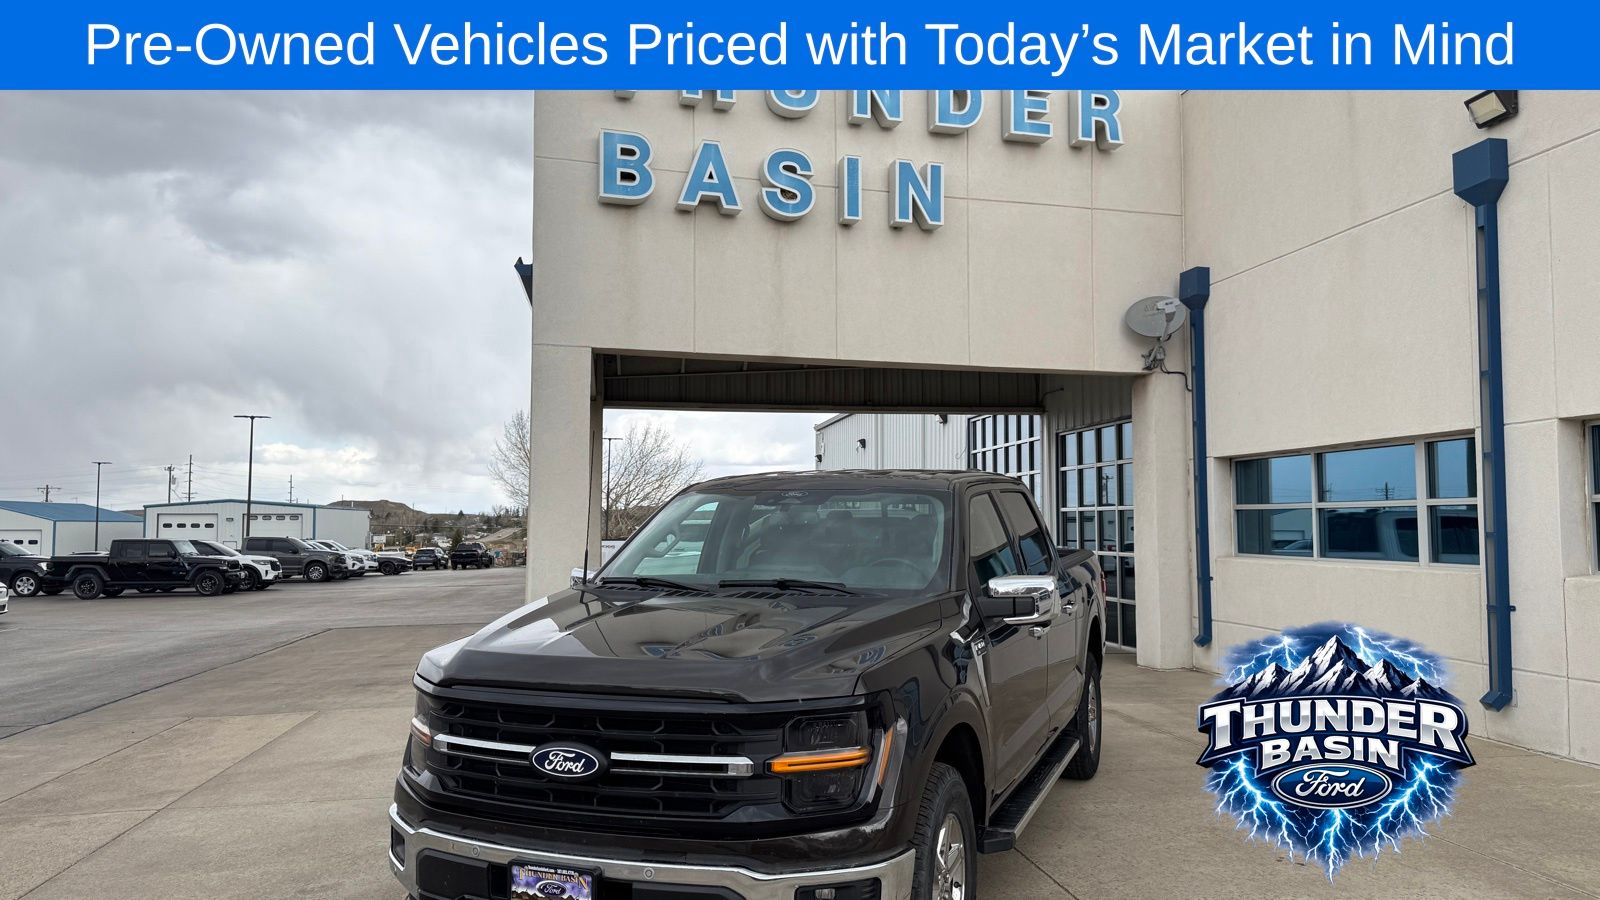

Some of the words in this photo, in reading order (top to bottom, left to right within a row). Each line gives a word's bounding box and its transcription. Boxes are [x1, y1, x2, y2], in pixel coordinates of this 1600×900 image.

[598, 129, 944, 230] BASIN
[544, 750, 586, 773] Ford
[543, 884, 562, 895] Ford
